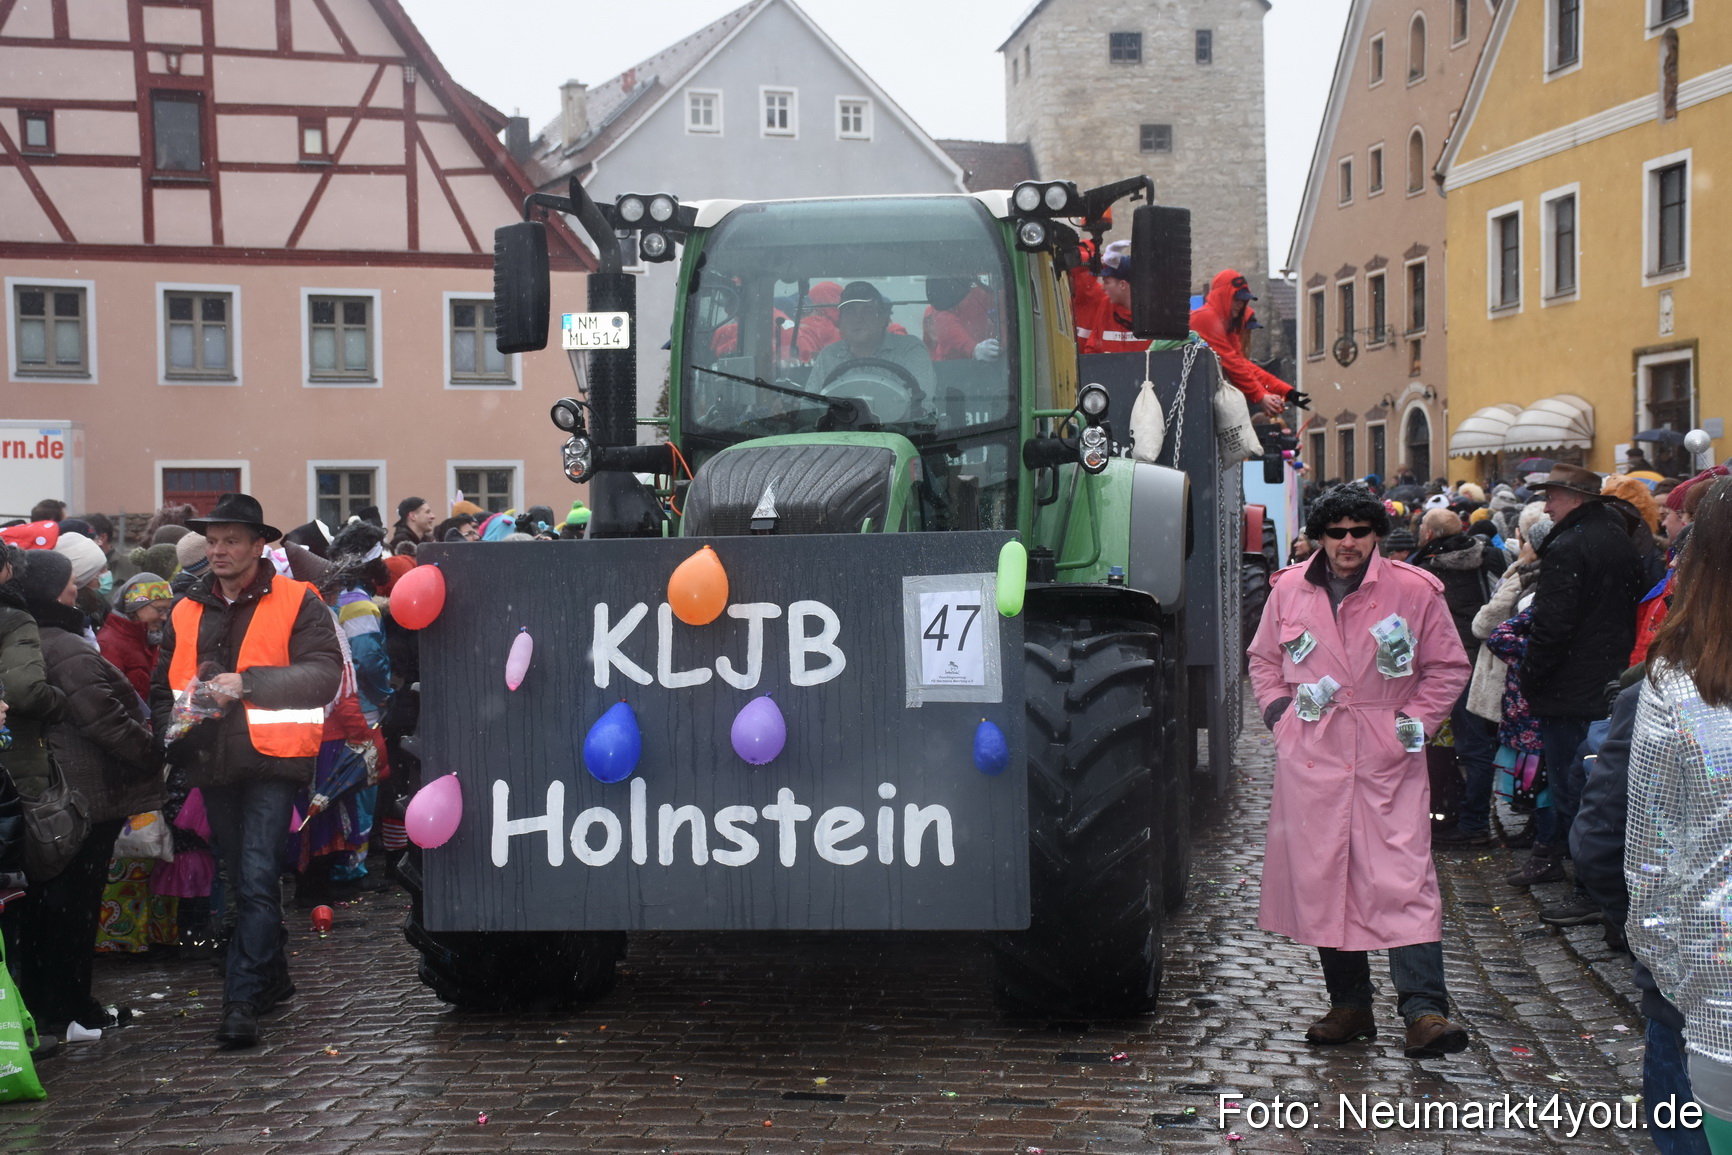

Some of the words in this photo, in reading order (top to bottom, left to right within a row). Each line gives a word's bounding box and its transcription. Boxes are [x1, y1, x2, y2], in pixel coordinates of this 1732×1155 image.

[569, 332, 588, 346] ML
[592, 332, 620, 346] 514
[578, 316, 598, 329] NM
[2, 434, 65, 460] rn.de
[592, 600, 847, 690] KLJB
[922, 604, 981, 652] 47
[491, 777, 956, 868] Holnstein
